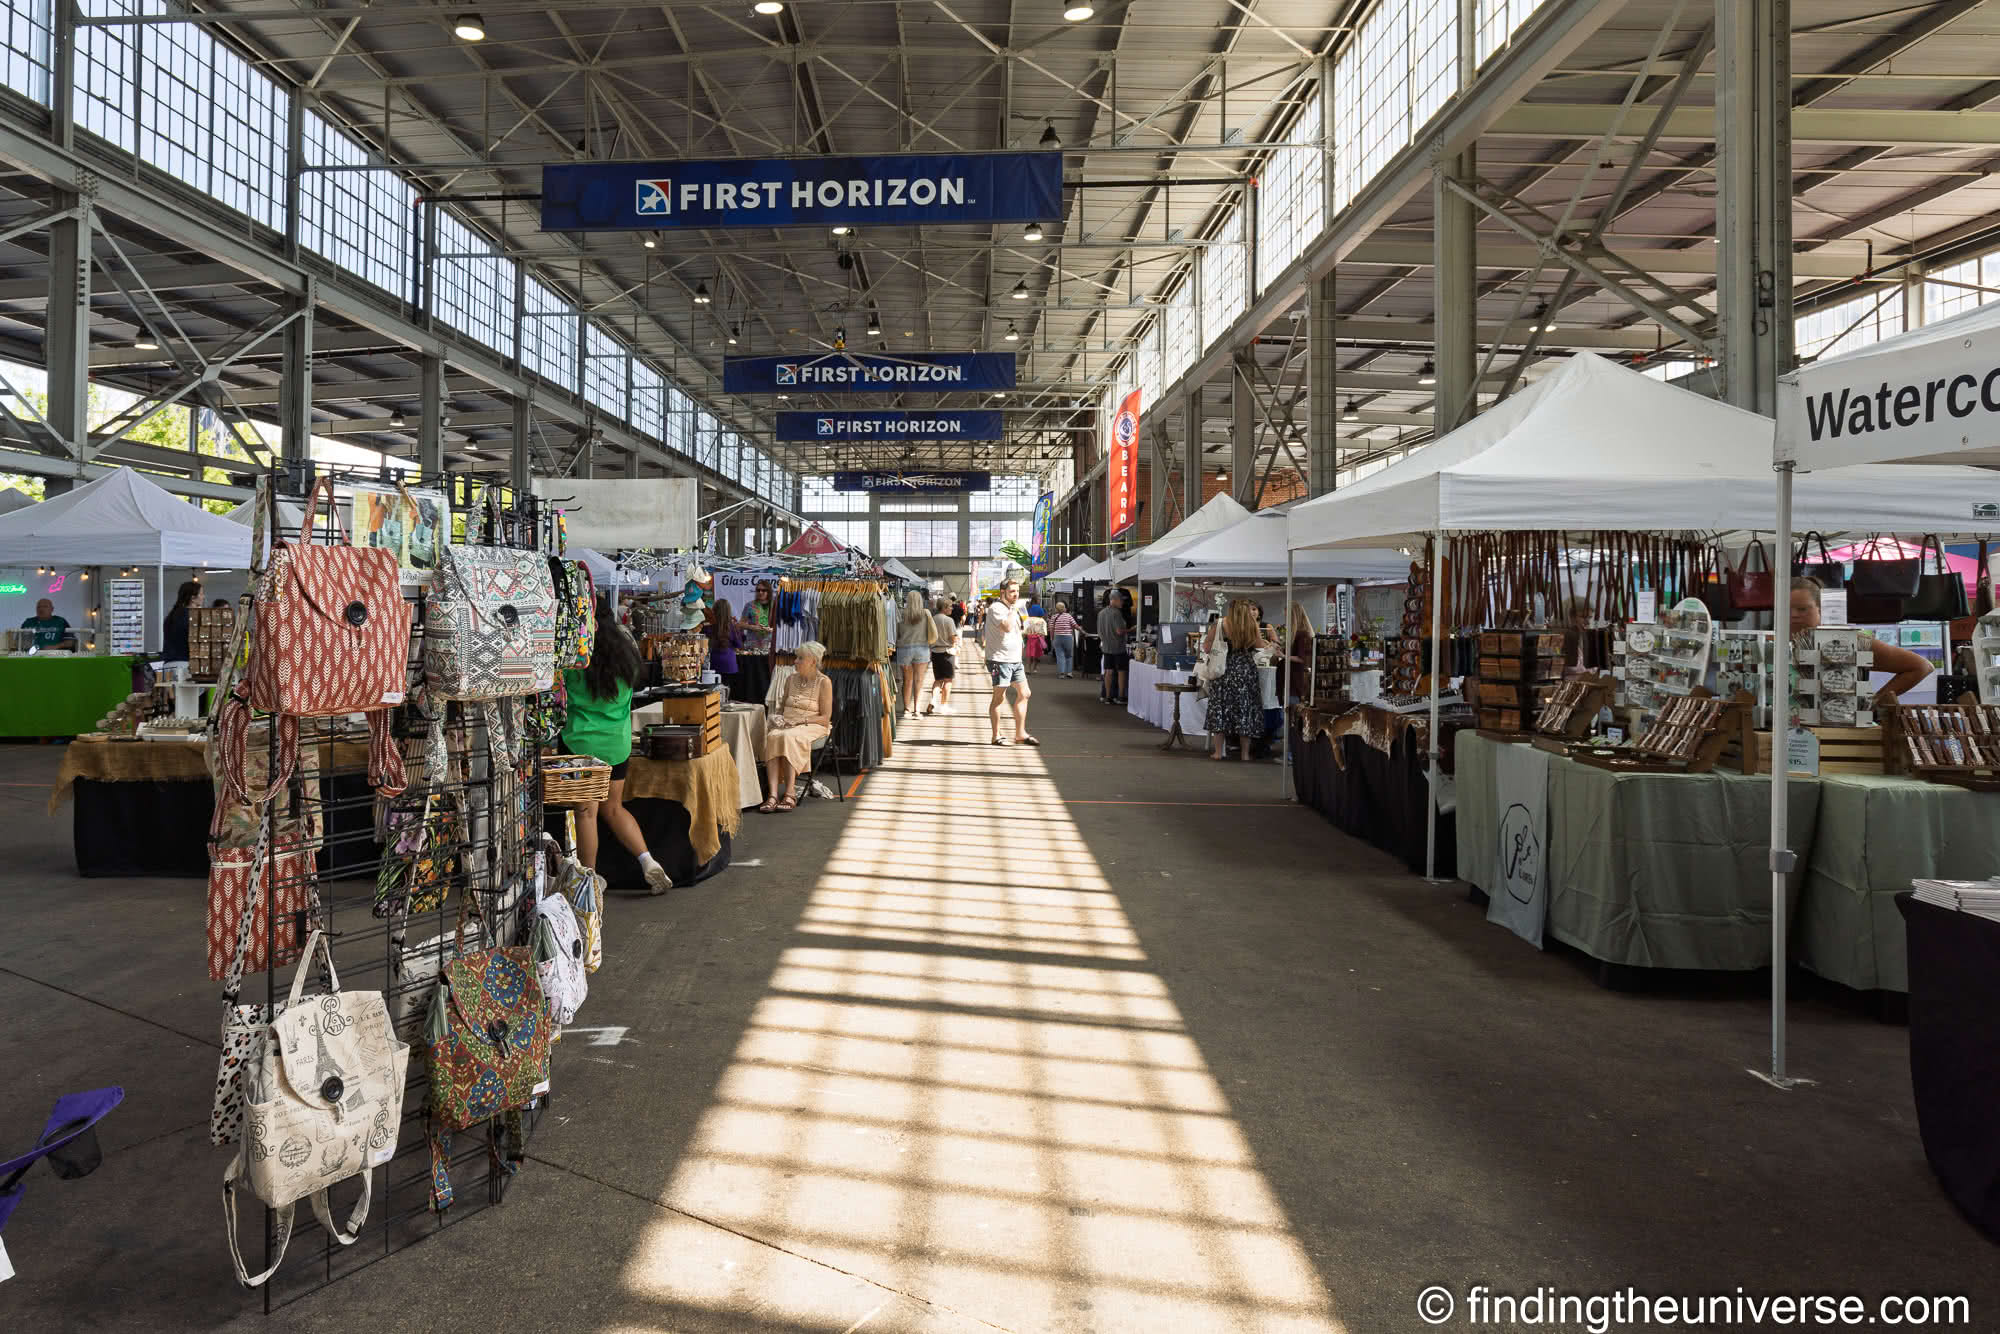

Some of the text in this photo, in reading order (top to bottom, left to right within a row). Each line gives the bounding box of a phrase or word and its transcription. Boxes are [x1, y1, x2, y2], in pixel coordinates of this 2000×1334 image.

[680, 182, 782, 210] FIRST
[791, 177, 964, 208] HORIZON
[801, 365, 961, 382] FIRST HORIZON
[837, 420, 961, 433] FIRST HORIZON
[1120, 450, 1129, 524] BEARD
[721, 574, 750, 586] Glass
